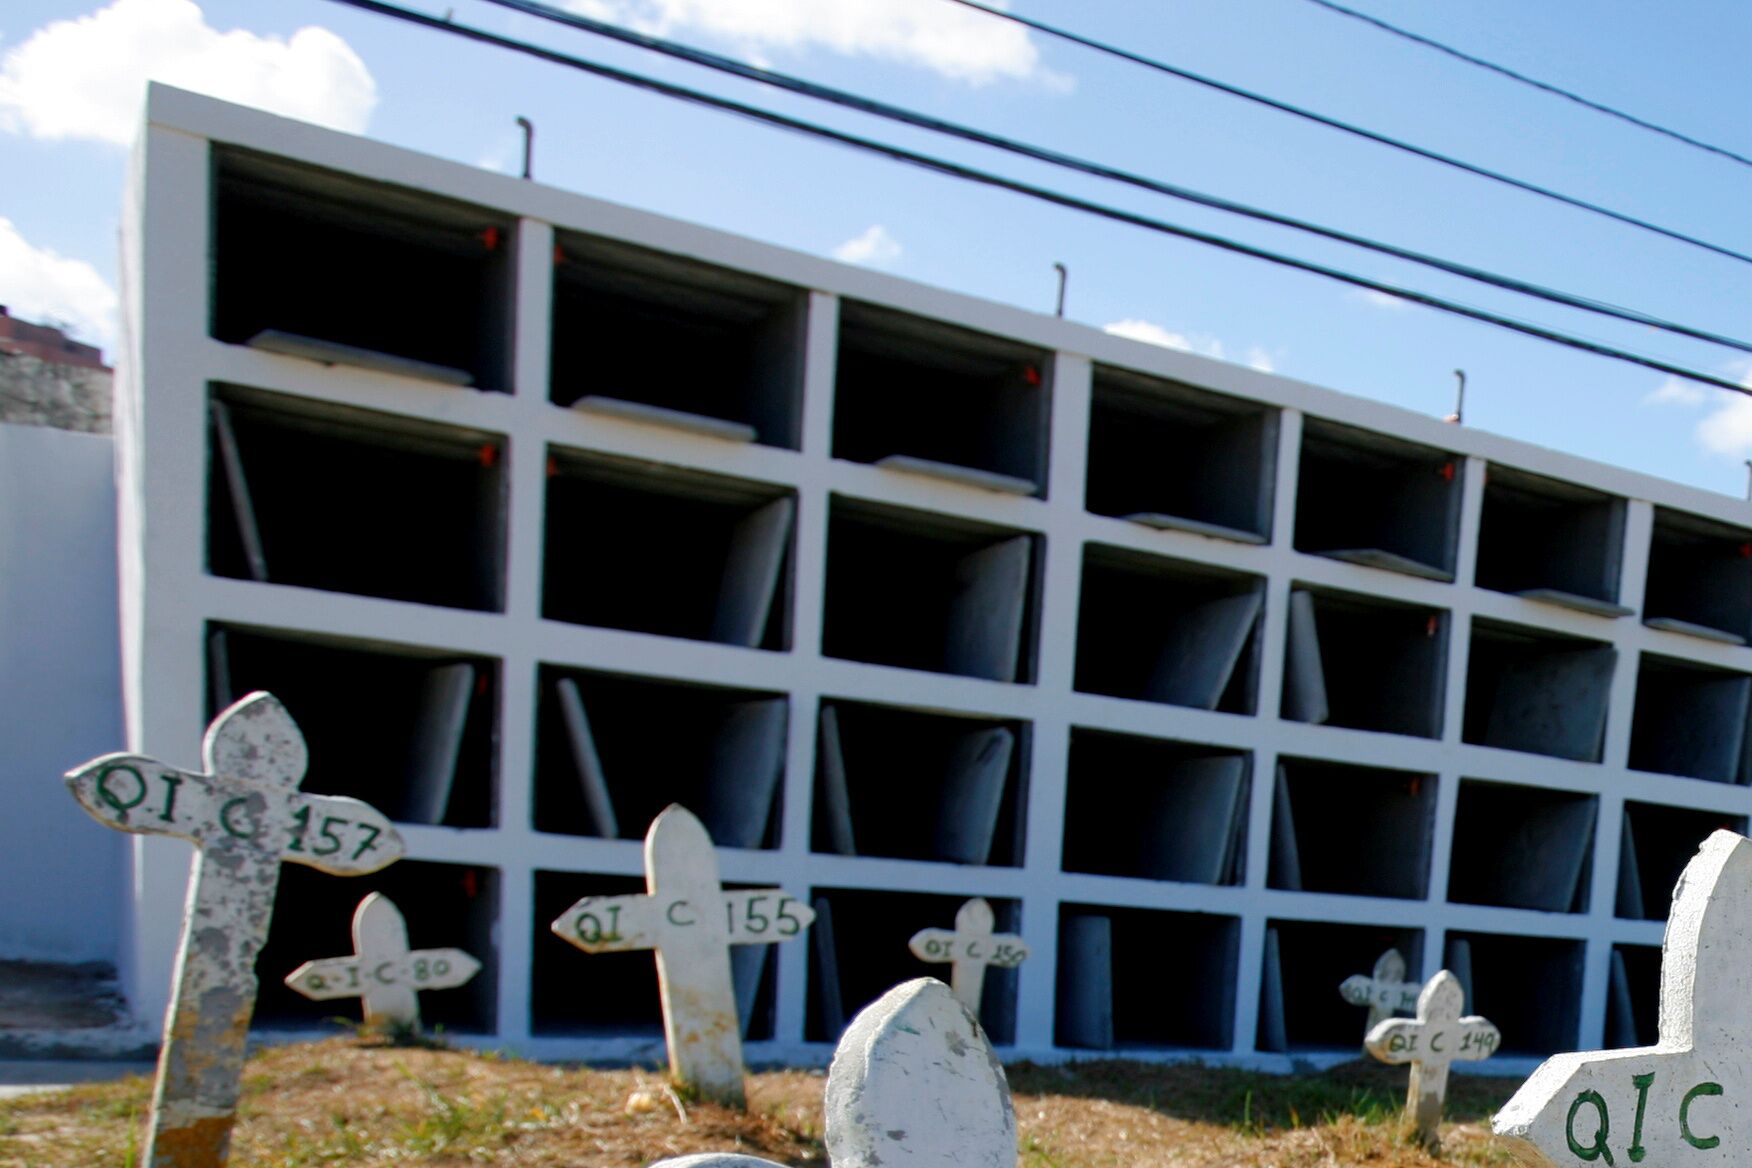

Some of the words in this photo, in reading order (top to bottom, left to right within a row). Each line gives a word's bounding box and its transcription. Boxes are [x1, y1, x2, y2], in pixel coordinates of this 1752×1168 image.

[287, 804, 382, 860] 157
[665, 900, 695, 926] C
[726, 897, 801, 935] 155
[1430, 1031, 1445, 1052] C
[1459, 1032, 1496, 1053] 149
